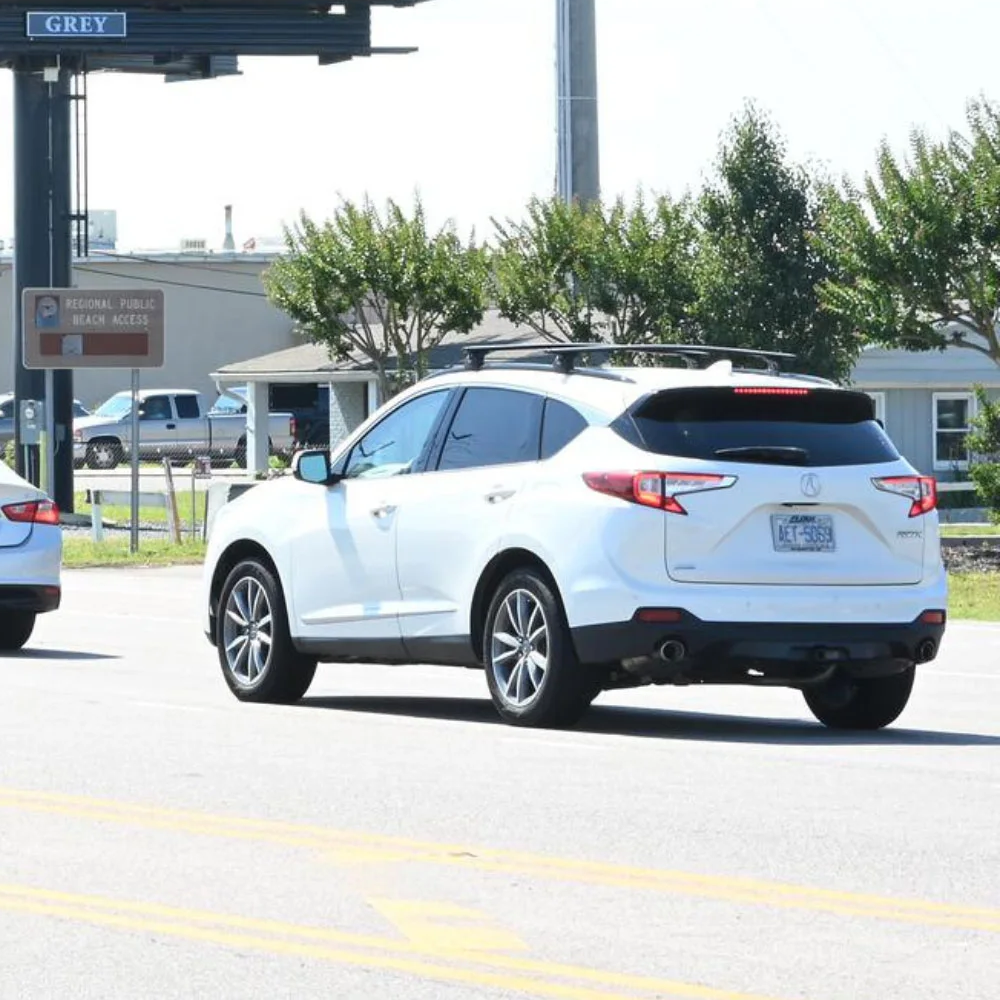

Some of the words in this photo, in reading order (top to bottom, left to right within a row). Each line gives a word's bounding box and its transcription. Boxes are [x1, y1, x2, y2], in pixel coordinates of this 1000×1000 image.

[45, 15, 108, 33] GREY
[65, 299, 113, 310] REGIONAL
[120, 299, 155, 310] PUBLIC
[72, 314, 105, 325] BEACH
[112, 314, 149, 325] ACCESS
